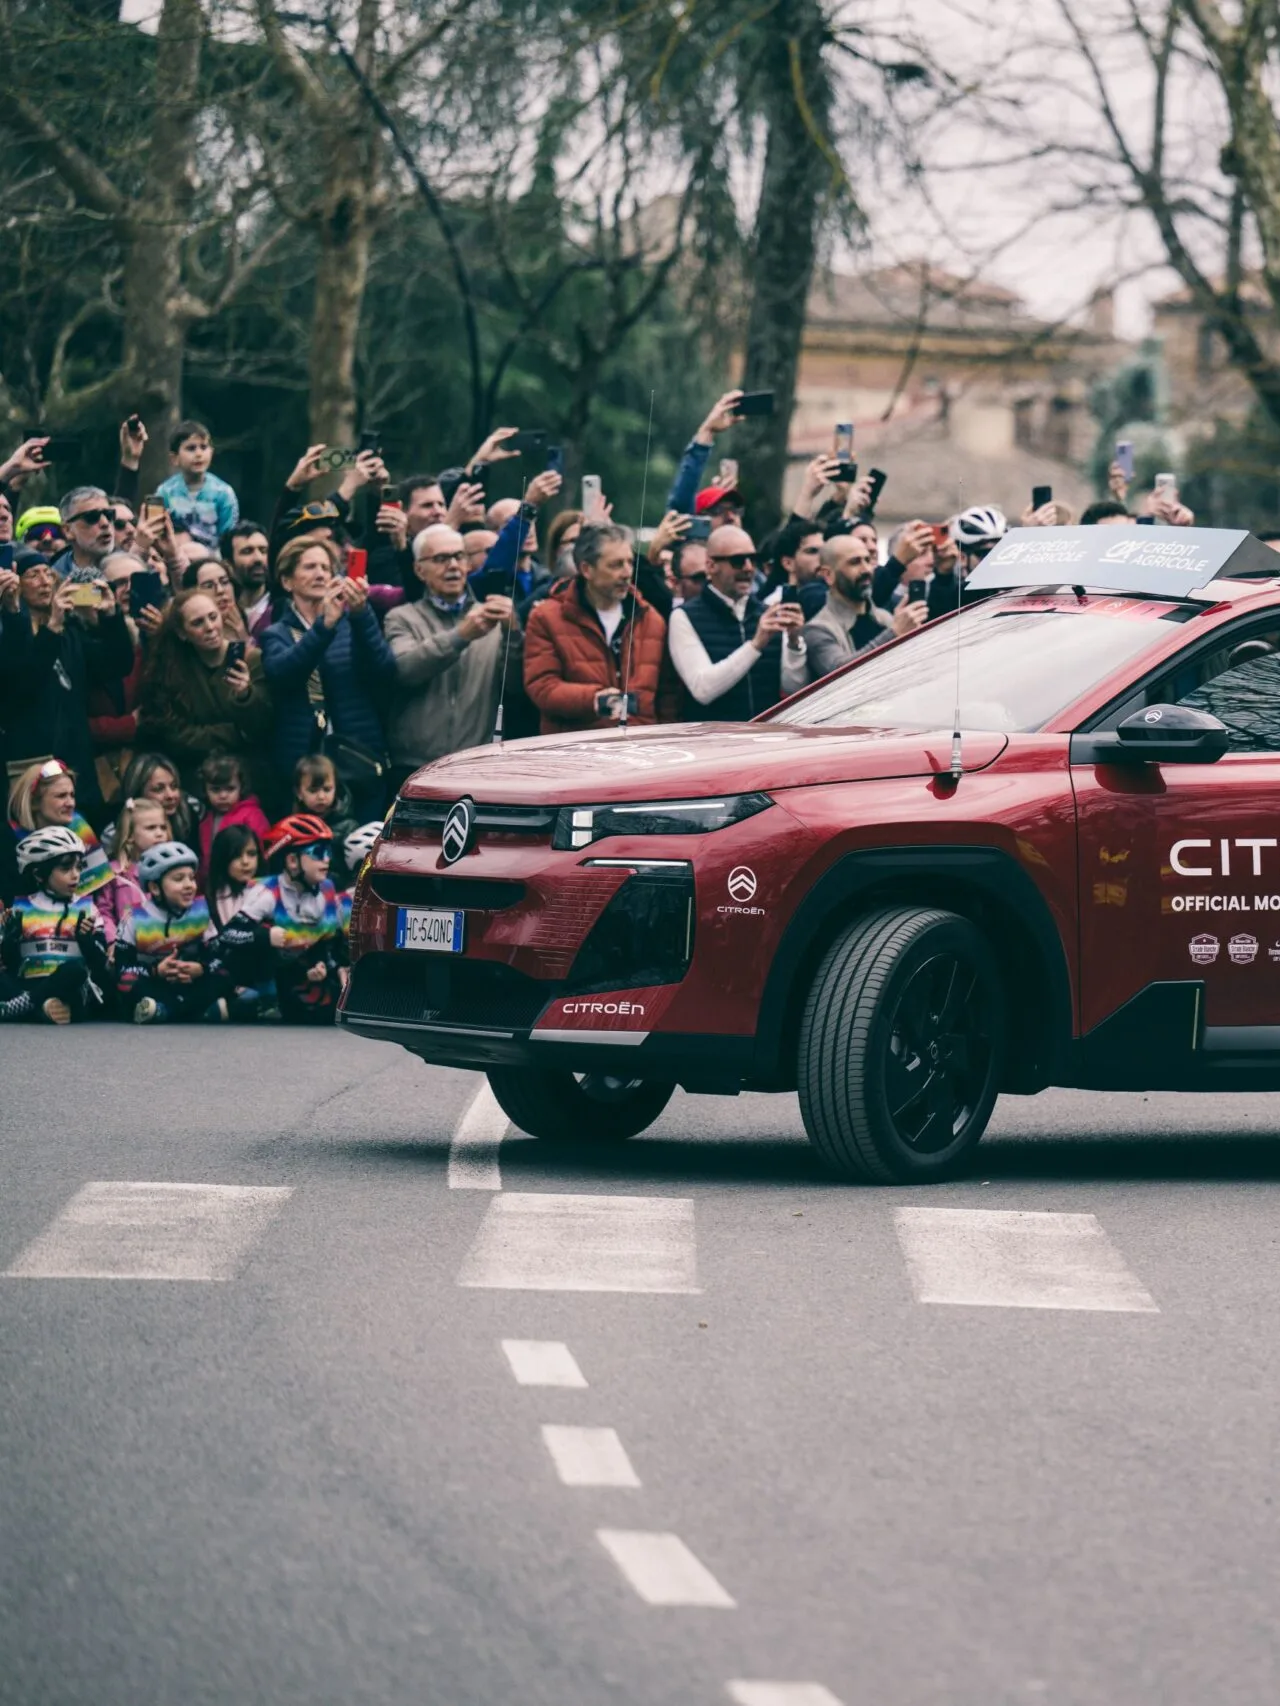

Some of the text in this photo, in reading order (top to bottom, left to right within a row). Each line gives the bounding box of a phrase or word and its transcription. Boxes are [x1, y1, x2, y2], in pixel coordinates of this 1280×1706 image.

[1026, 538, 1081, 553] CRÉDIT
[1142, 540, 1201, 556] CRÉDIT
[1018, 551, 1088, 564] AGRICOLE
[1130, 554, 1209, 572] AGRICOLE
[1171, 895, 1250, 911] OFFICIAL
